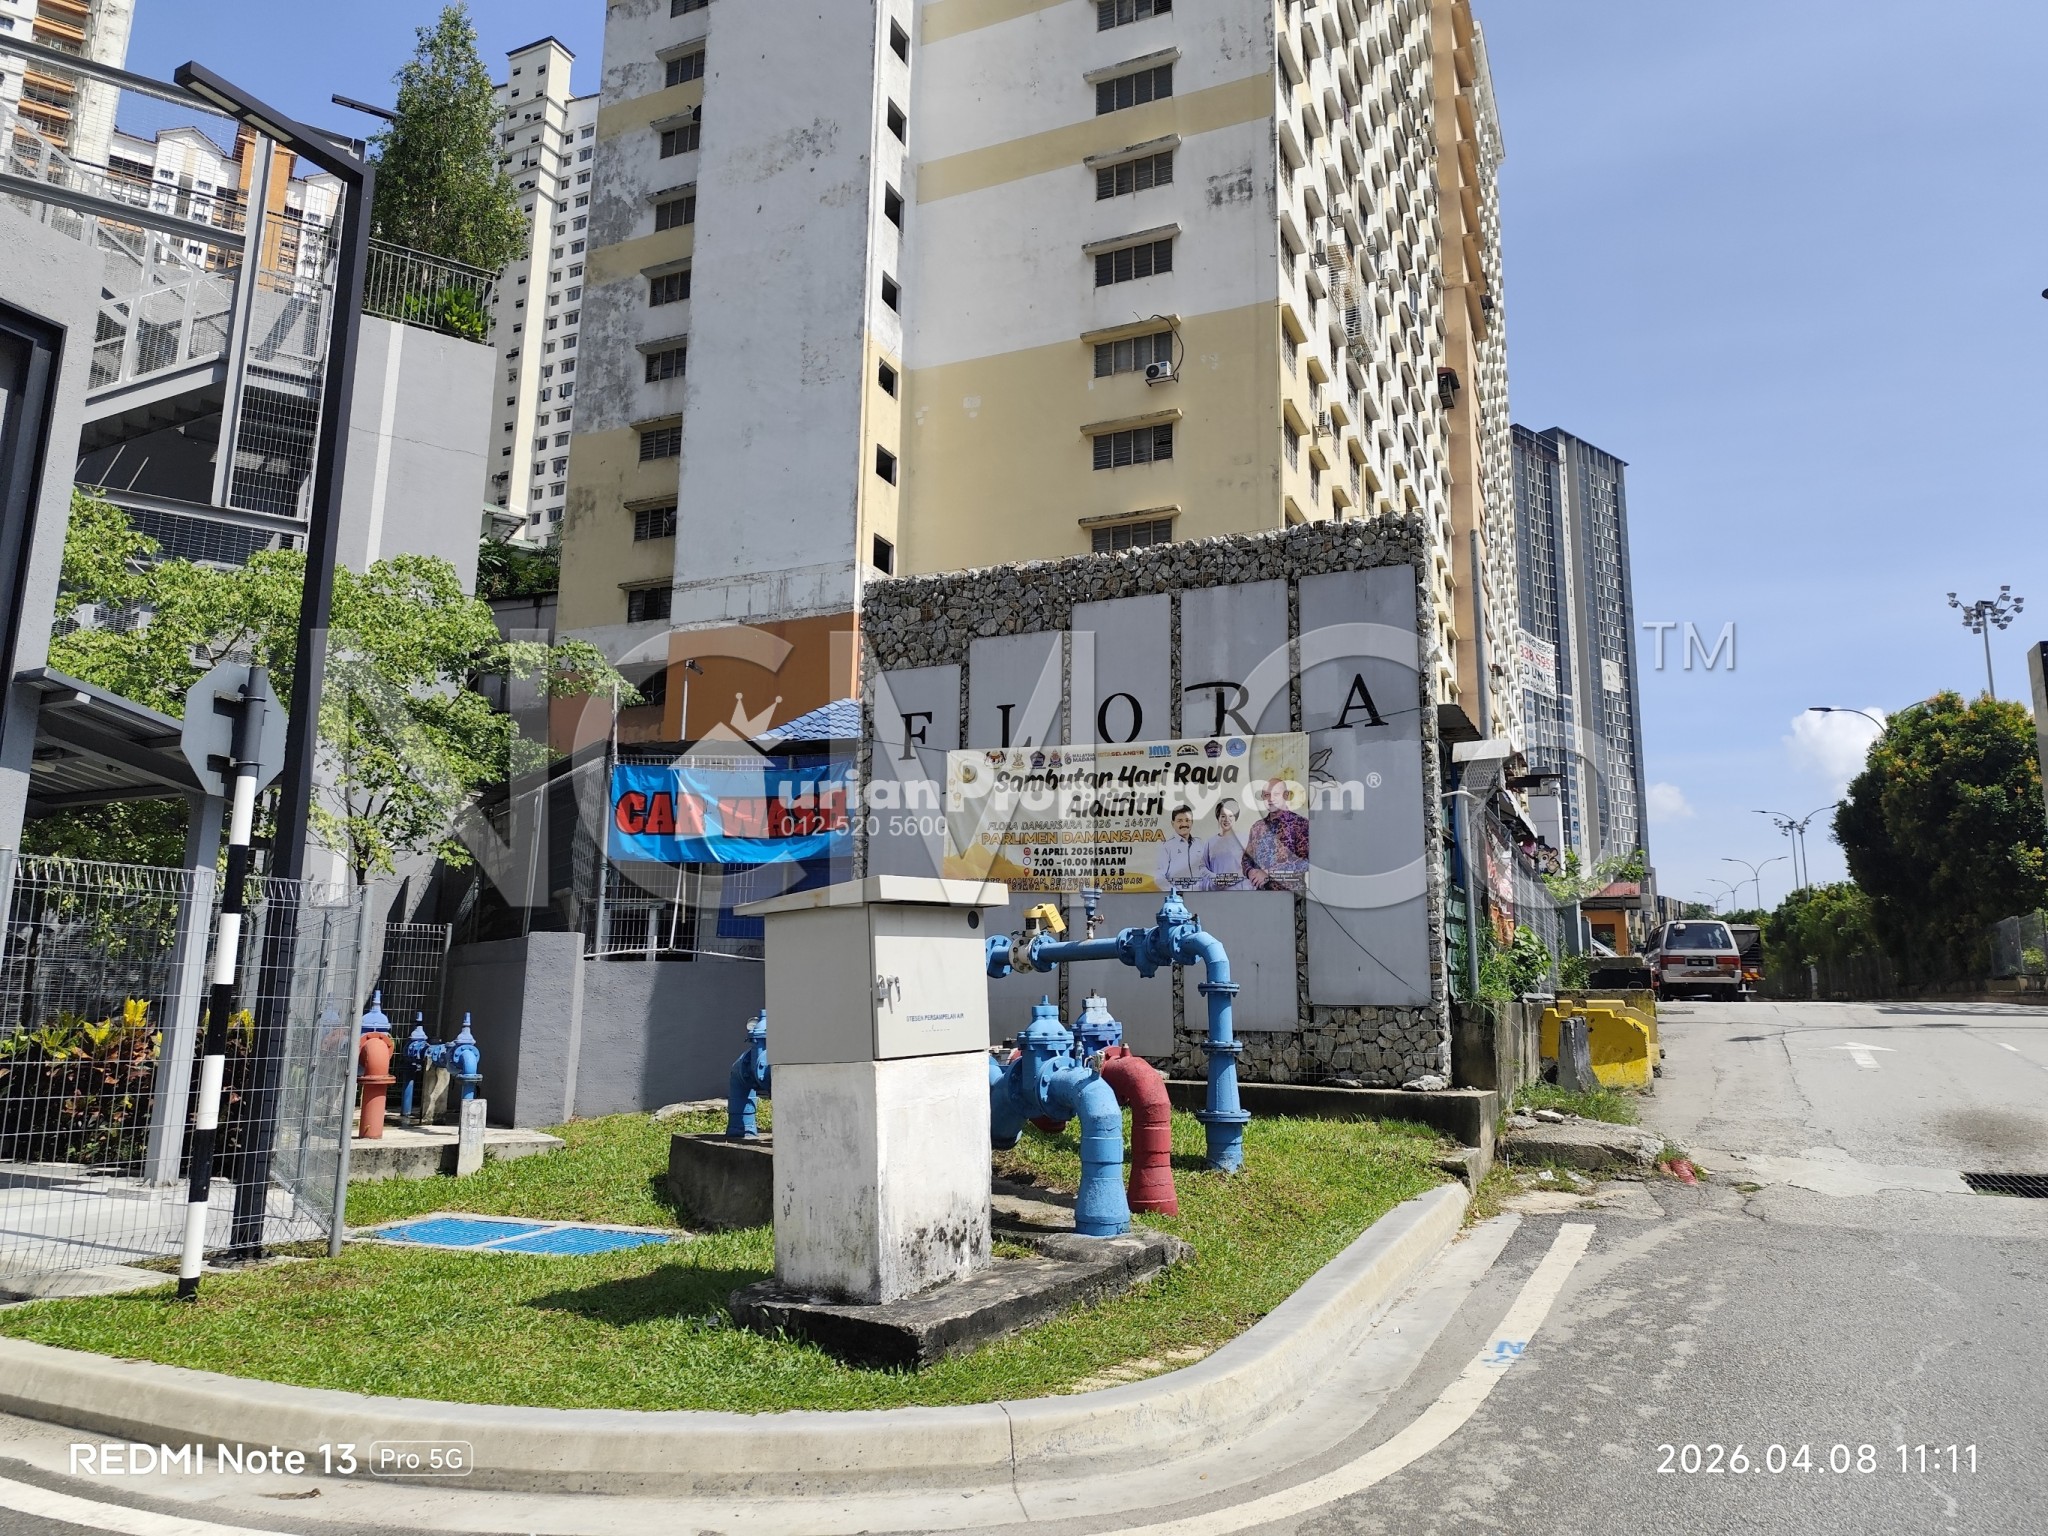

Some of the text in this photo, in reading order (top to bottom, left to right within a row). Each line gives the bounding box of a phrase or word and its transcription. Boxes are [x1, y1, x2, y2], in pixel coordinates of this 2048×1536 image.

[995, 762, 1239, 793] Sambutan Hari Raya
[1066, 788, 1166, 818] Aidilfitri
[614, 787, 847, 839] CAR WASH
[1021, 820, 1083, 831] DAMANSARA
[1086, 819, 1111, 829] 2026
[981, 829, 1166, 846] PARLIMEN DAMANSARA
[1034, 847, 1039, 856] 4
[1042, 847, 1068, 856] APRIL
[1034, 858, 1054, 867] 7.00
[1090, 857, 1126, 866] MALAM
[1033, 868, 1076, 877] DATARAN
[1078, 868, 1098, 877] JMB
[1101, 868, 1107, 877] A
[1119, 868, 1125, 877] B
